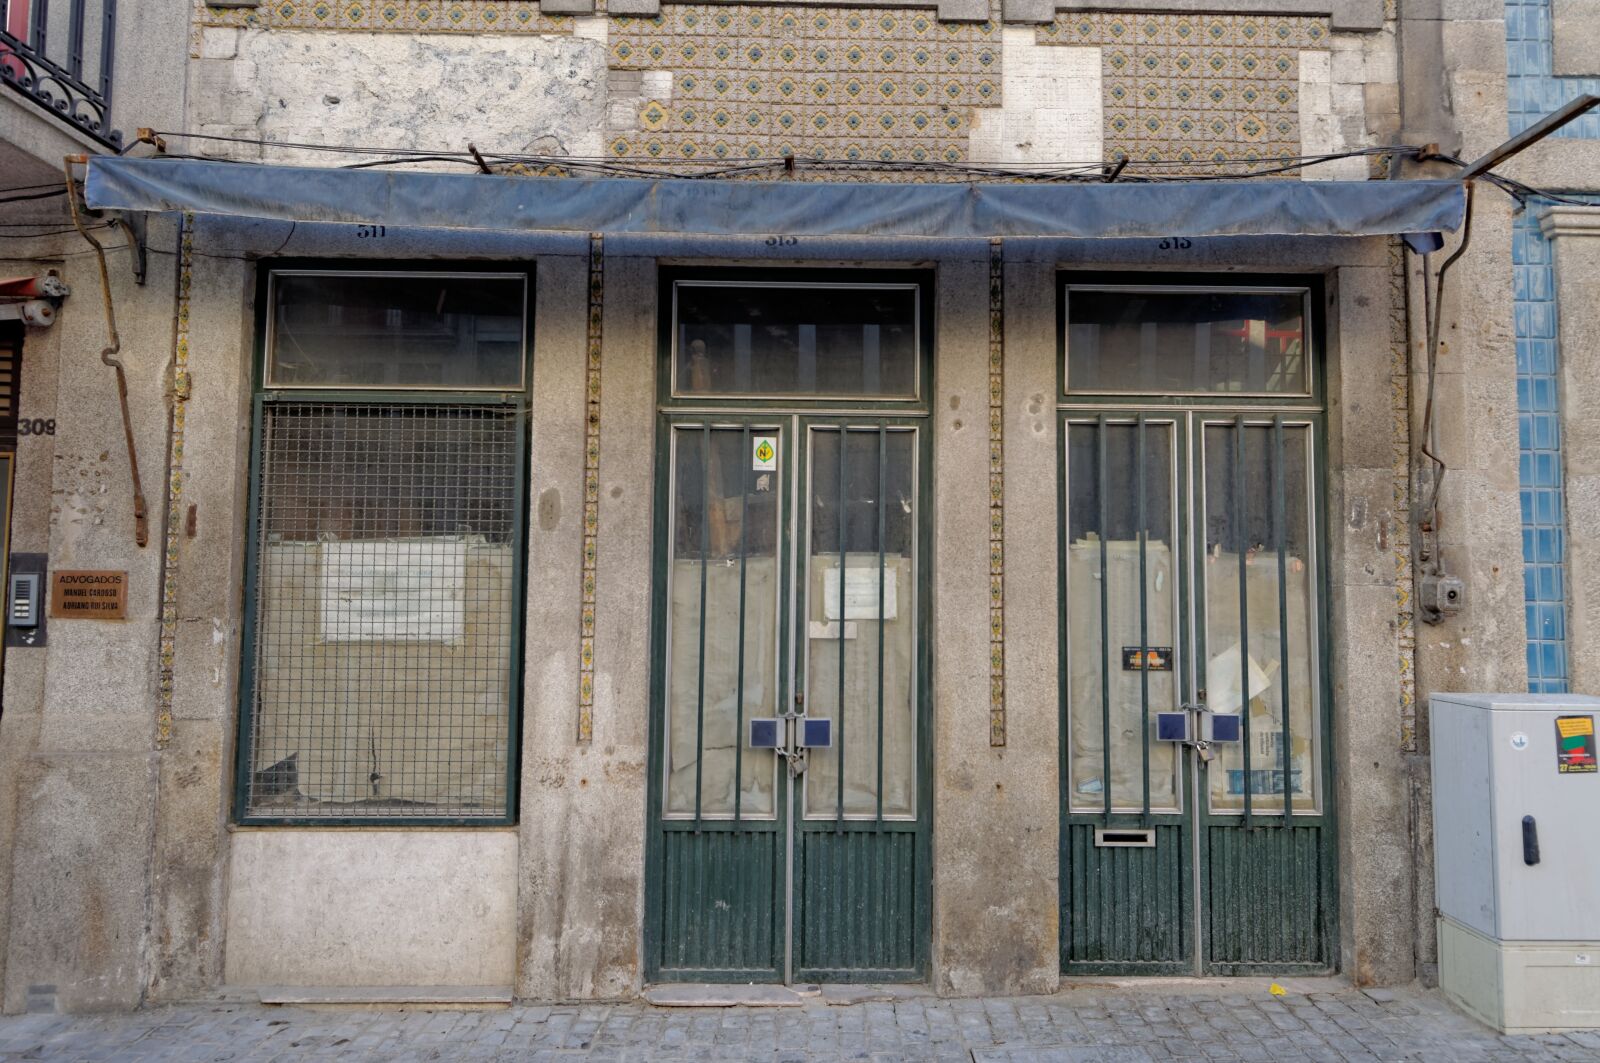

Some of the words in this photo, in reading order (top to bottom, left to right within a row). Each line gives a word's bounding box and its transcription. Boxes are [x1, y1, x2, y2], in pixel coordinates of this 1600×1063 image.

[357, 224, 386, 239] 311
[17, 417, 56, 436] 309
[59, 575, 122, 584] ADVOGADOS
[89, 588, 117, 597] CARDOSO
[63, 602, 89, 610] ADRIANO
[102, 602, 118, 610] SILVA
